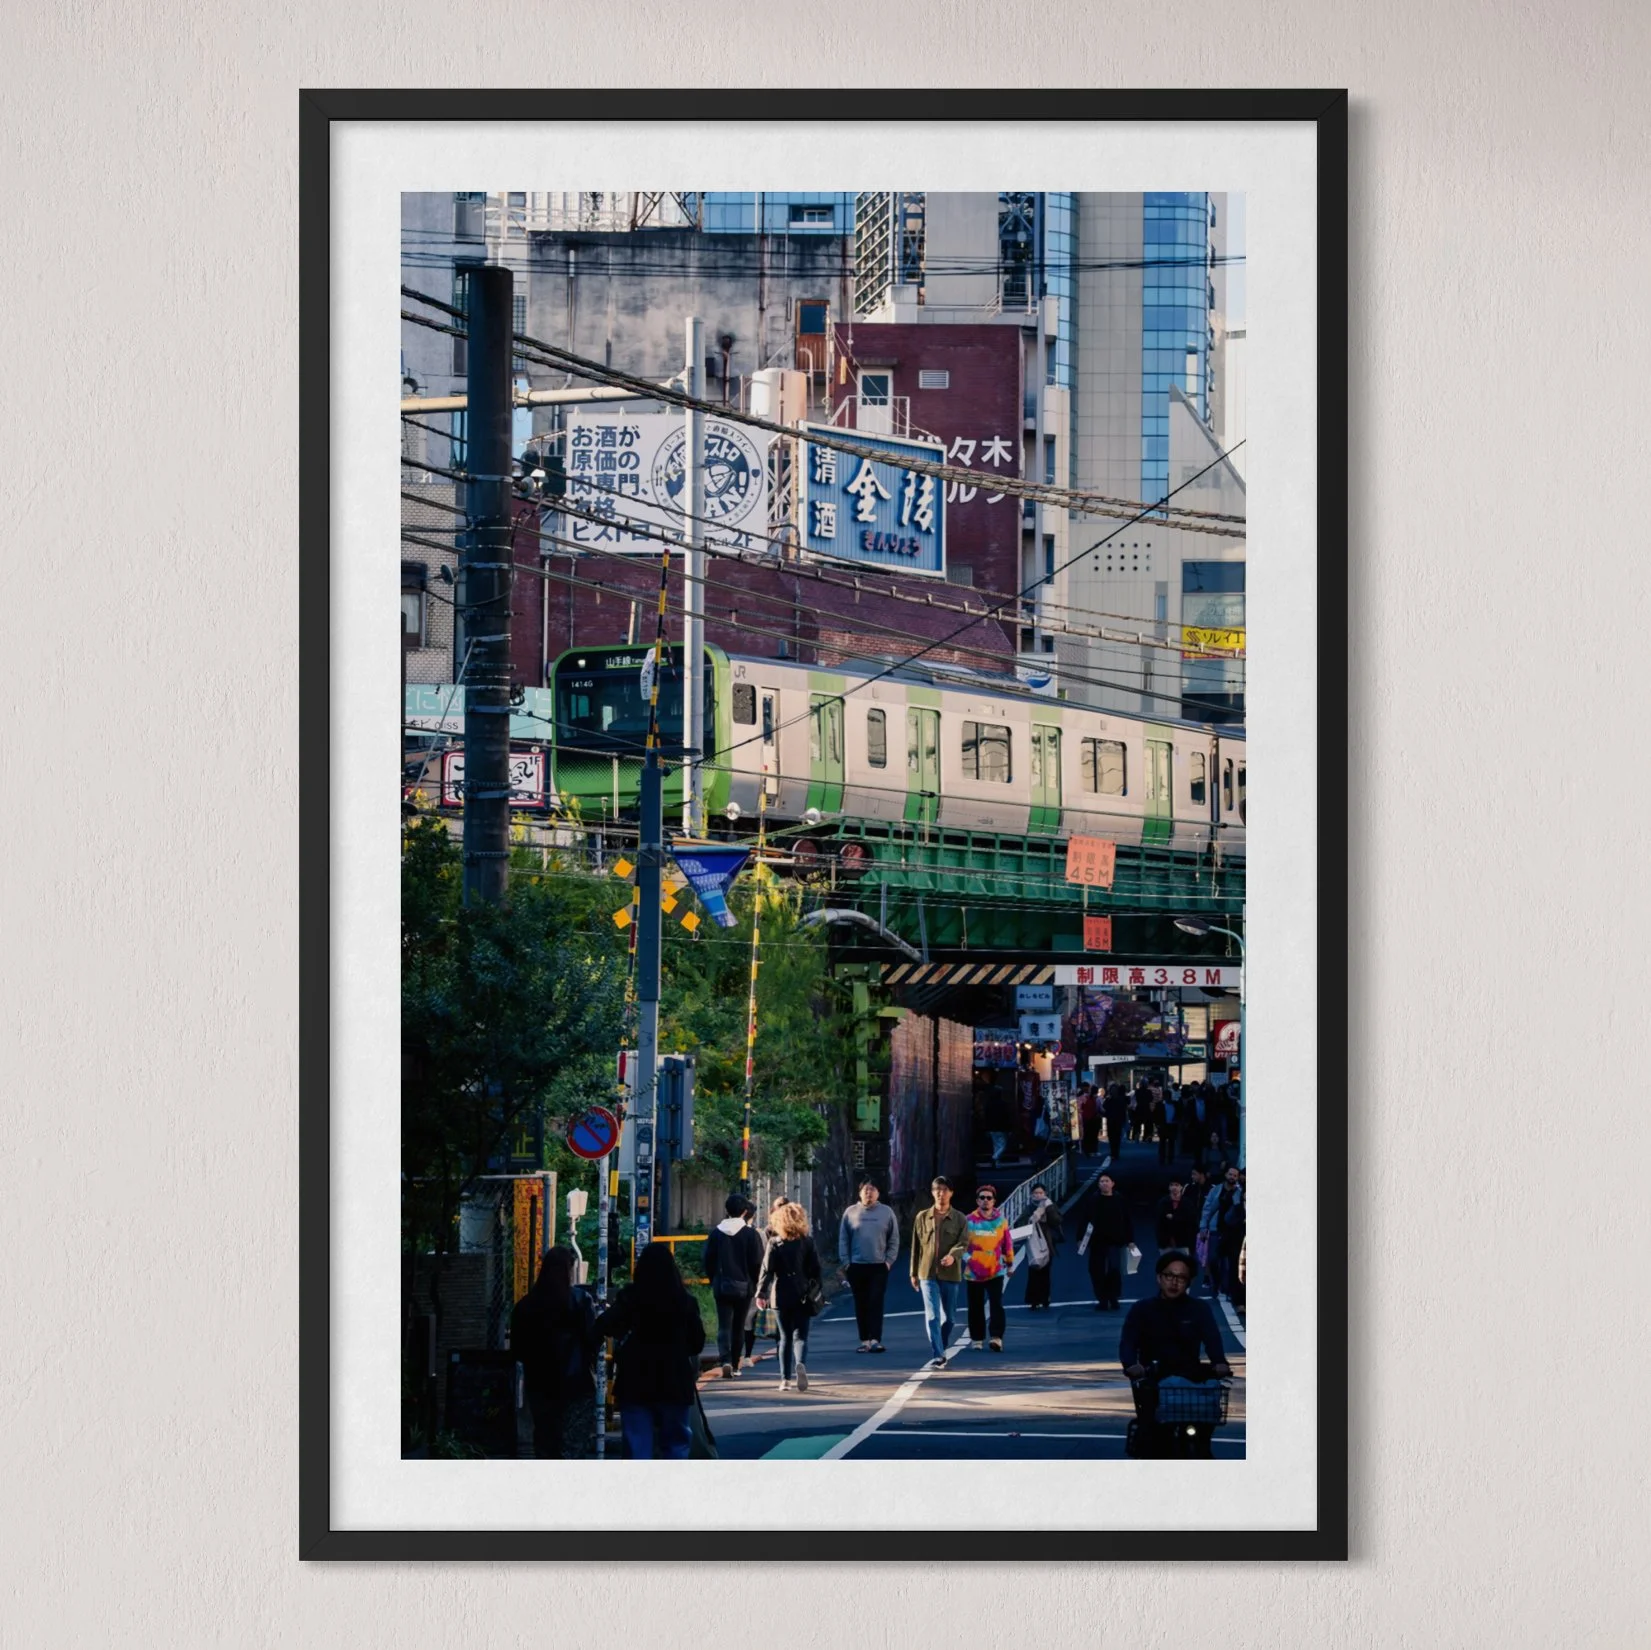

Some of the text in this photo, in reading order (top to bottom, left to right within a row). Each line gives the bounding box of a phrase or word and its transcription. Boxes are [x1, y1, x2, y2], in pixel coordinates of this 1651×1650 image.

[571, 425, 641, 448] お酒が
[571, 449, 640, 472] 原価の
[918, 435, 1013, 467] 々木
[814, 446, 837, 539] 清酒
[573, 520, 650, 543] ビストロ
[734, 665, 747, 679] JR
[529, 756, 541, 765] 1F
[1077, 966, 1221, 985] 制限高3.8M
